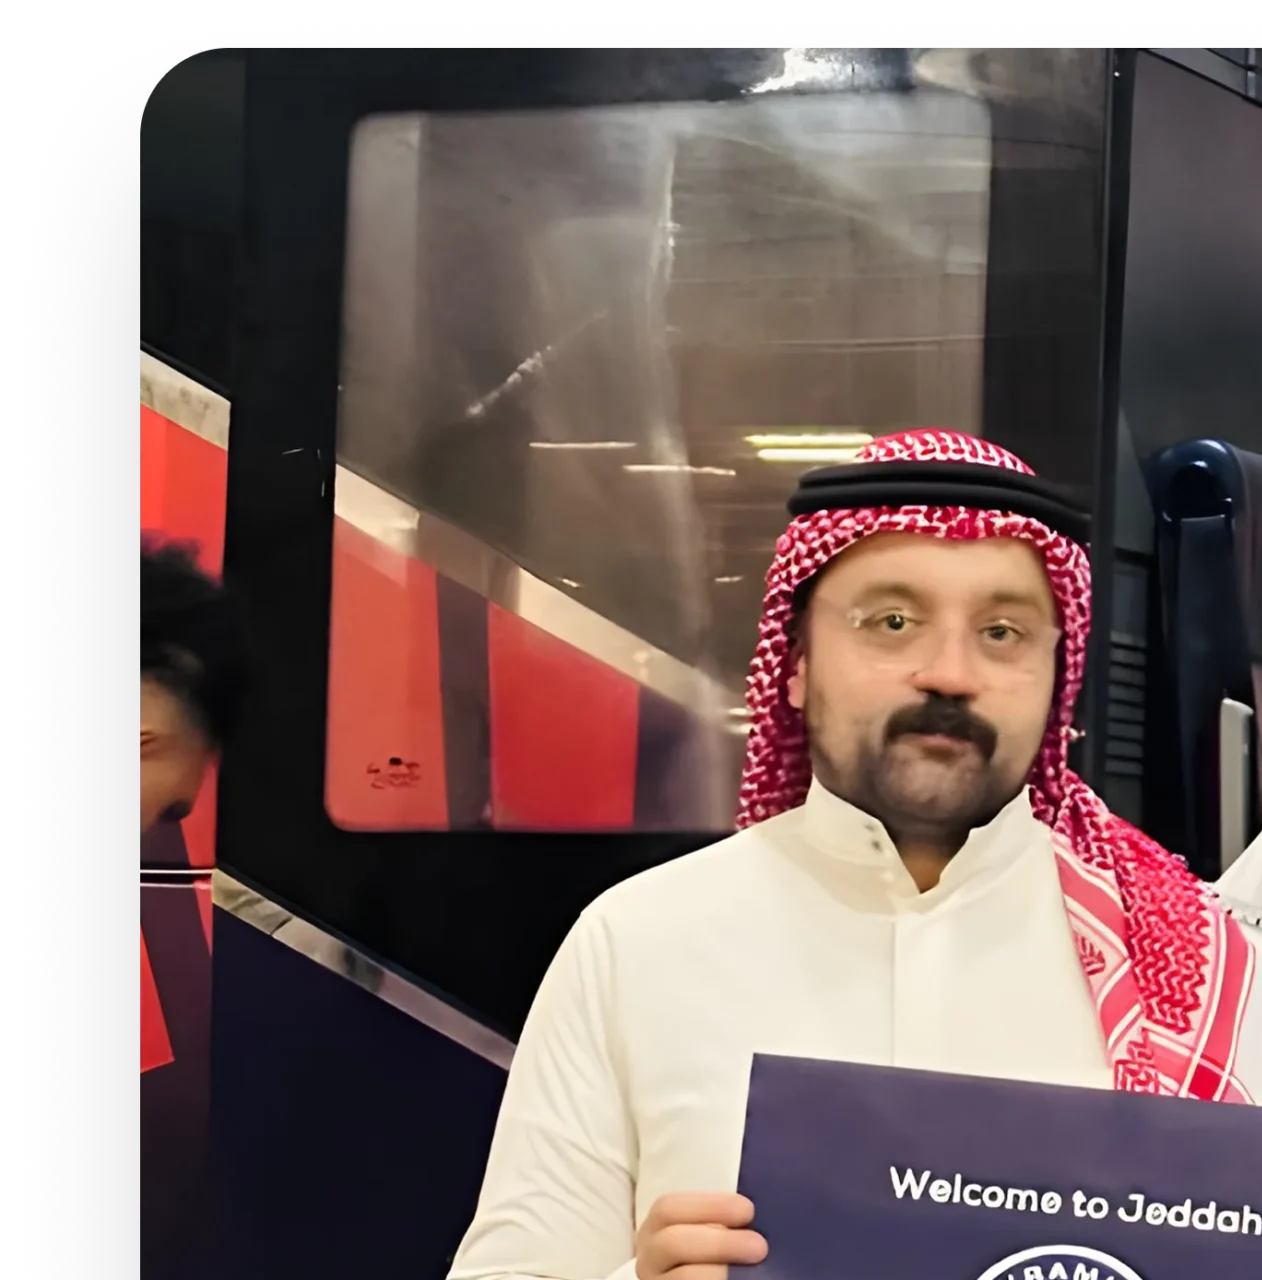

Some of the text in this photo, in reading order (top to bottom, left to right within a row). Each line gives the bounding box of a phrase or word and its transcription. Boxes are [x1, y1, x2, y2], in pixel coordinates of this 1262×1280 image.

[889, 1165, 1262, 1236] Welcome to Jeddah
